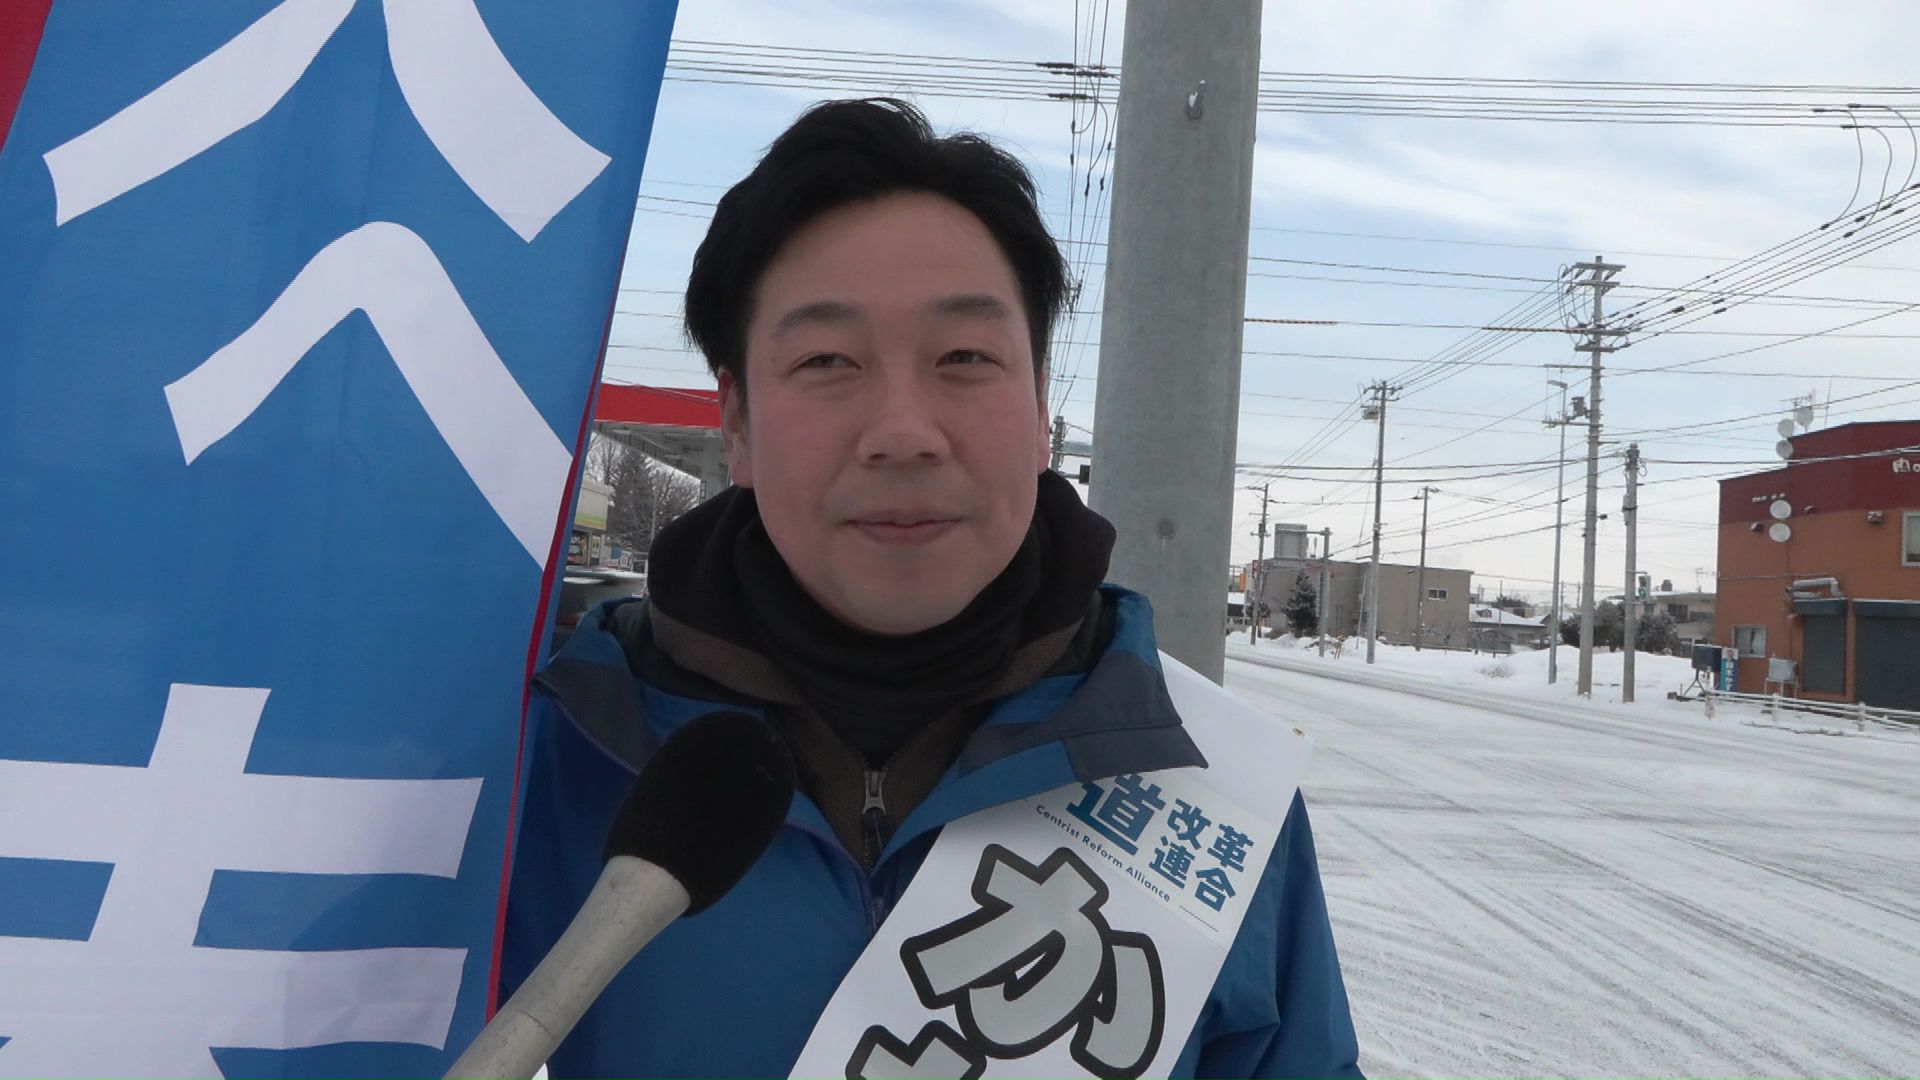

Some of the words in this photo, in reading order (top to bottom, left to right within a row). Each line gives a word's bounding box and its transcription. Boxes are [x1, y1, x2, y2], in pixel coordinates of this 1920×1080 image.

[1036, 804, 1080, 838] Centrist
[1082, 833, 1123, 868] Reform
[1125, 865, 1170, 902] Alliance
[845, 843, 1166, 1080] か
